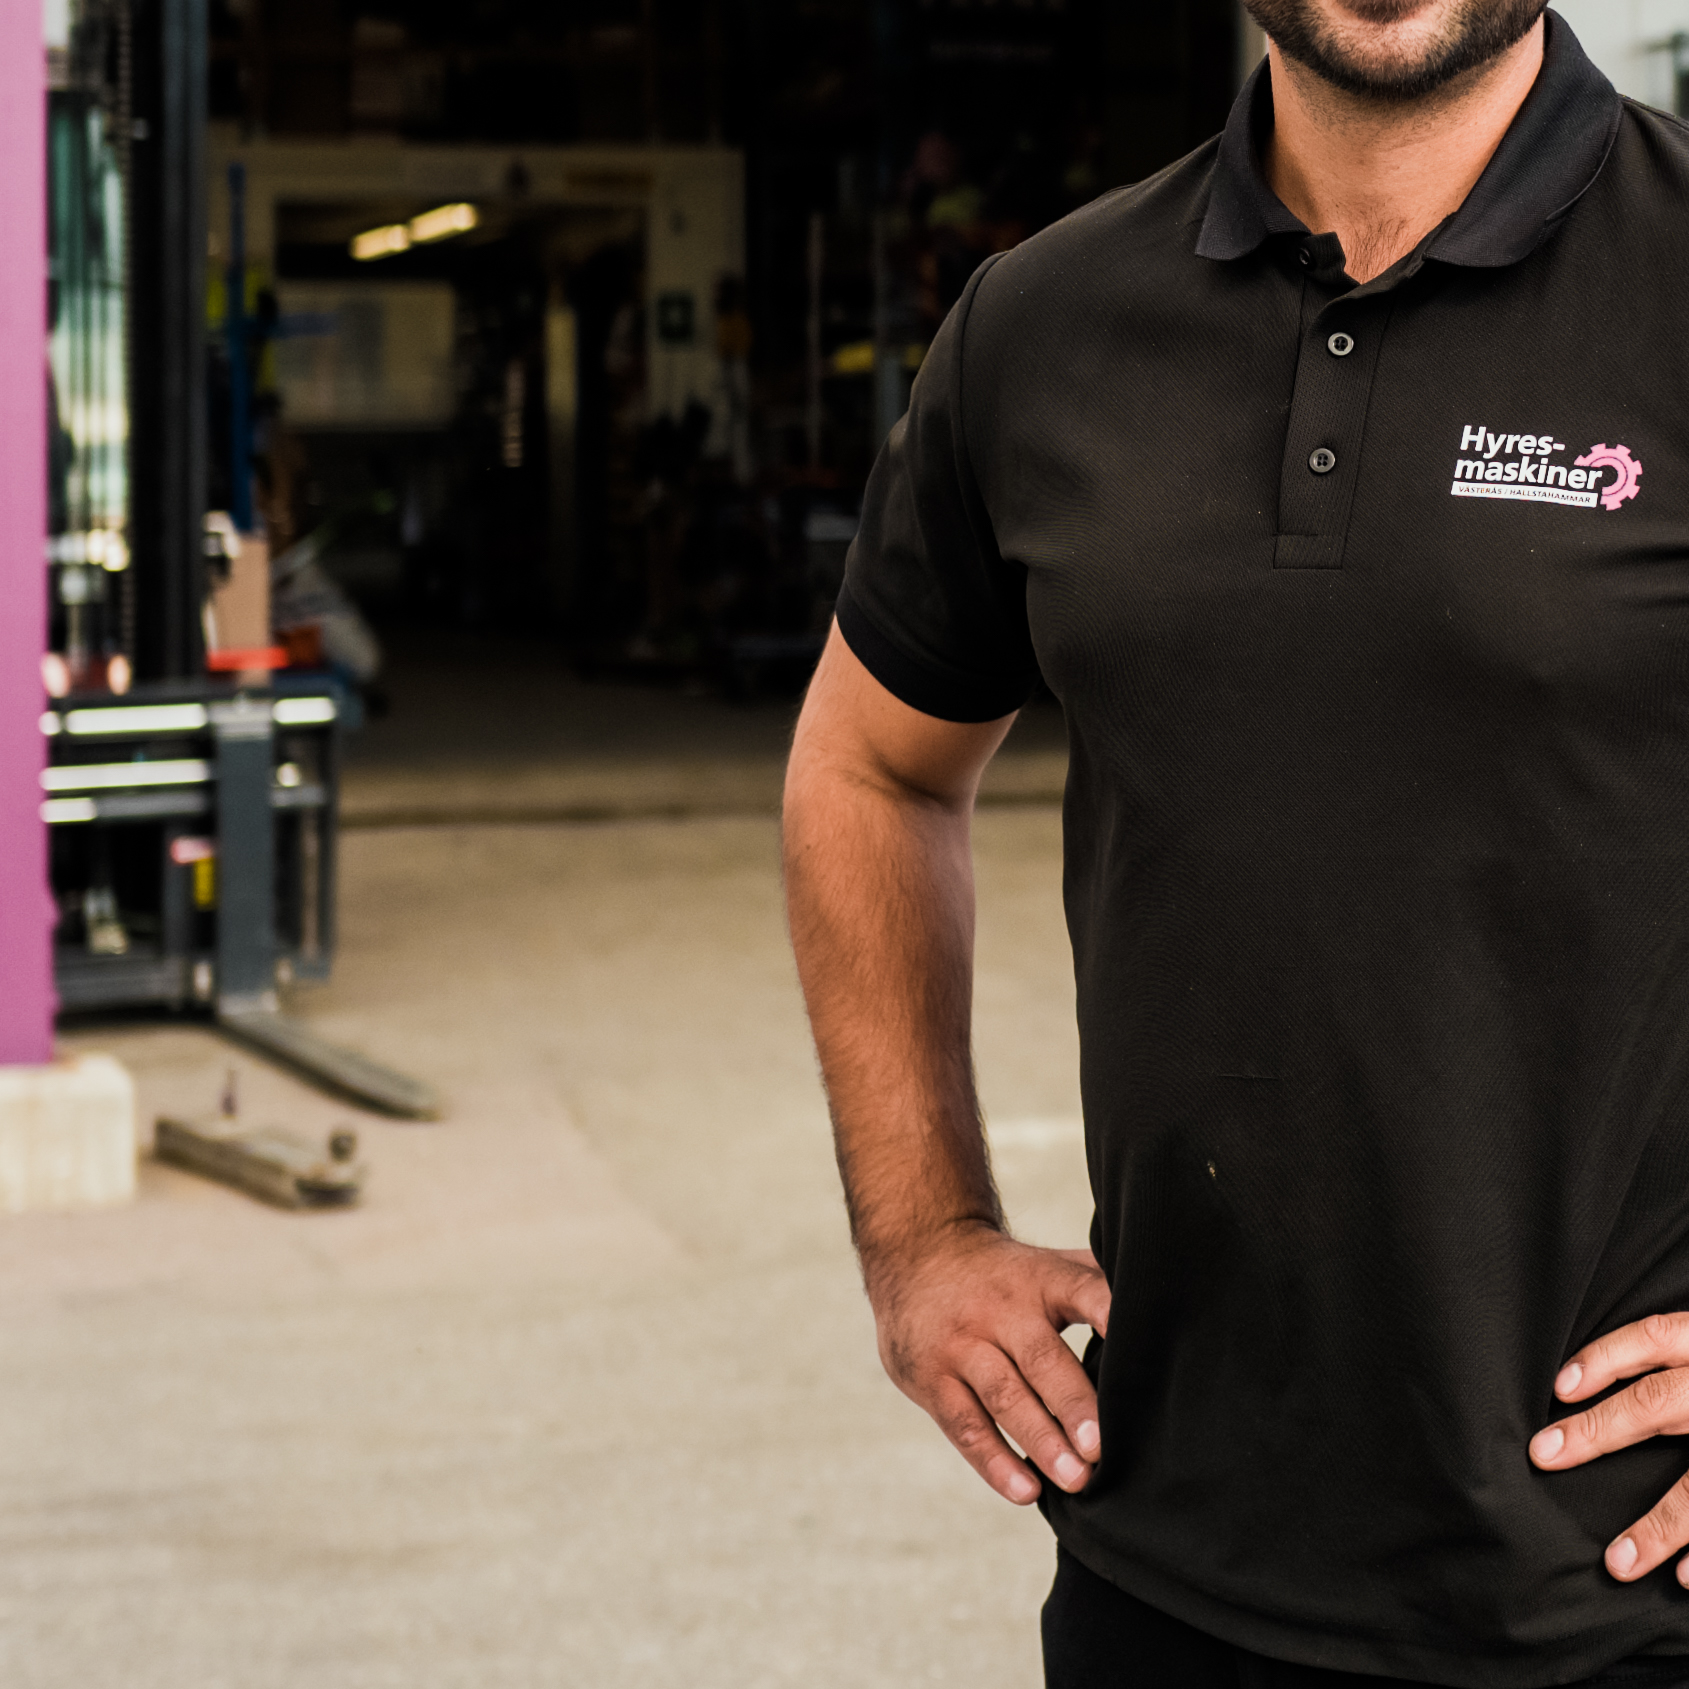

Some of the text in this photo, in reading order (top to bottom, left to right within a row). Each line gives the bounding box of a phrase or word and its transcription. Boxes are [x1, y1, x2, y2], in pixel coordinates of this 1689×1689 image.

[1459, 424, 1566, 460] Hyres-
[1453, 456, 1603, 490] maskiner
[1458, 485, 1502, 495] VÄSTERÅS
[1509, 488, 1591, 504] HALLSTAHAMMAR
